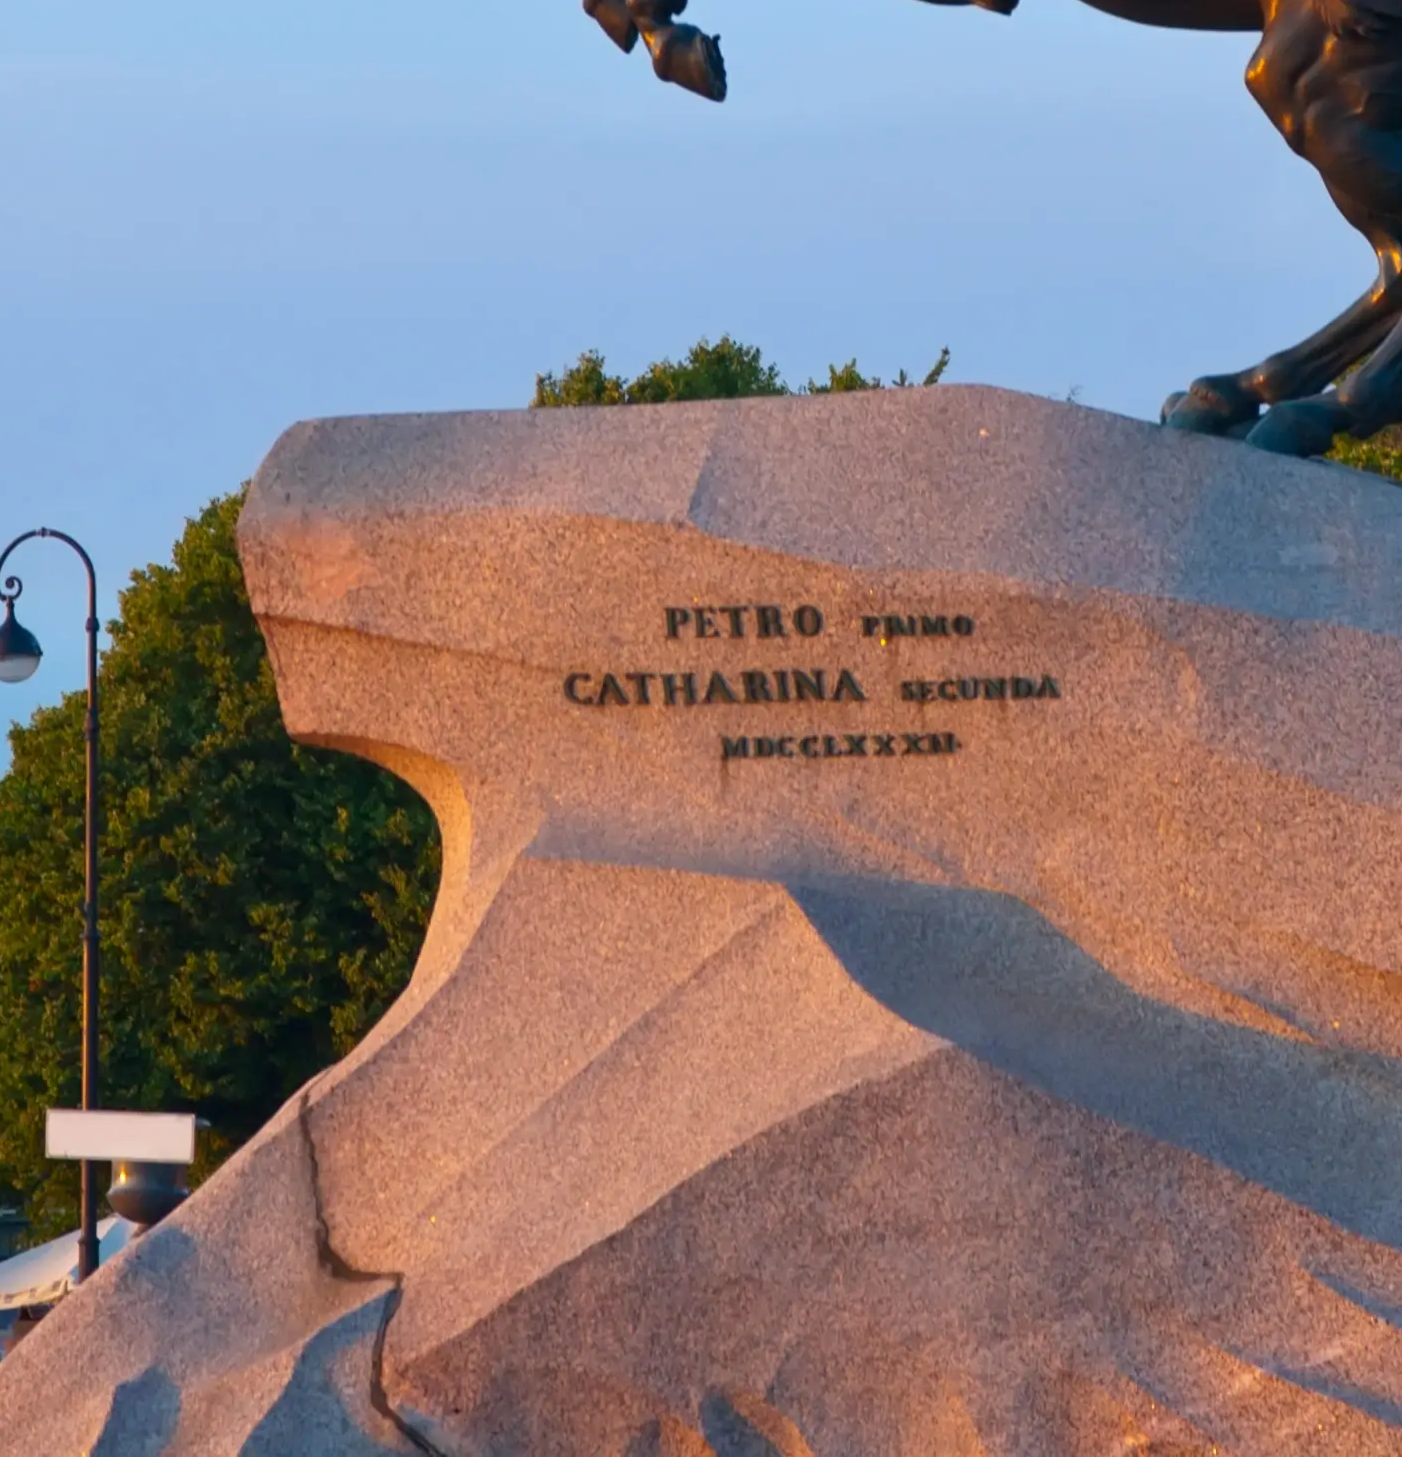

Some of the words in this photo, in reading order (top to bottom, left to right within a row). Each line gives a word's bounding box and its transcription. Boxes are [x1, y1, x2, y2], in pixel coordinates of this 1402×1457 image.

[664, 604, 824, 640] PETRO
[861, 614, 974, 637] PRIMO
[563, 668, 867, 706] CATHARINA
[900, 674, 1061, 702] SECUNDA
